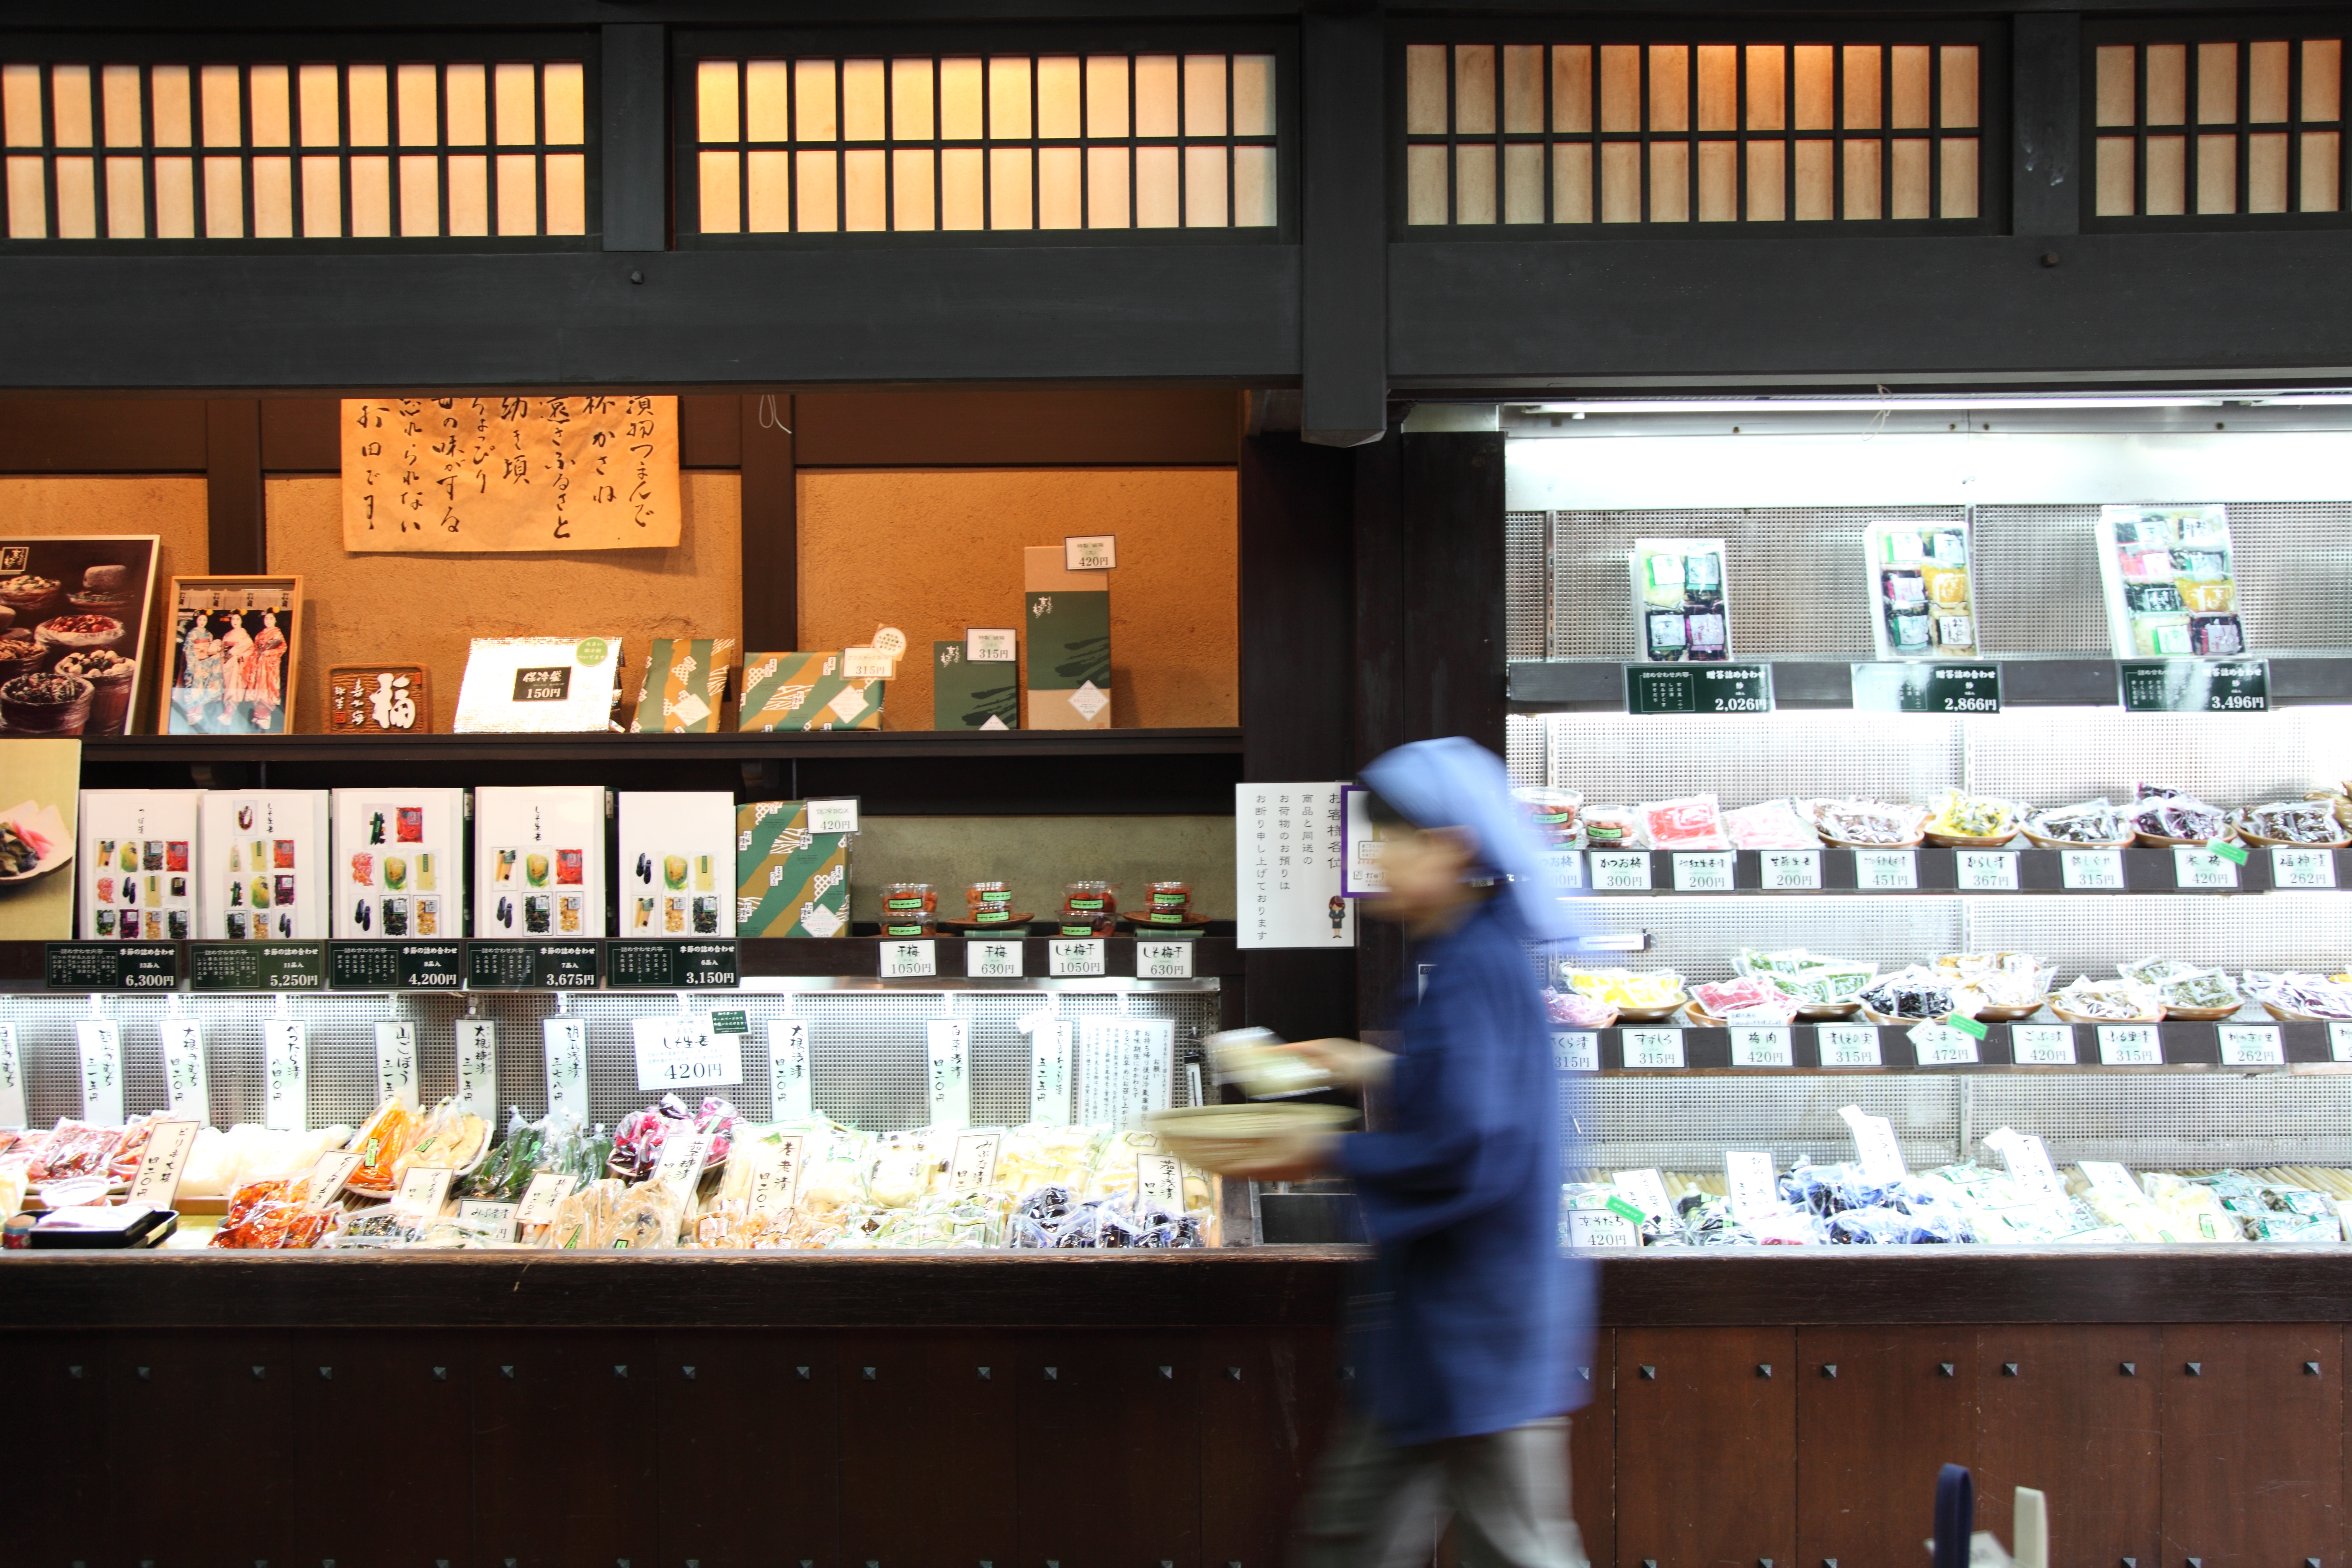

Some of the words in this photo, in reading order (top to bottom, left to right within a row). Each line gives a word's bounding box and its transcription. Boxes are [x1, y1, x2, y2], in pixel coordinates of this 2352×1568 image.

[1079, 557, 1109, 567] 420円
[979, 649, 1008, 659] 315円
[522, 670, 562, 682] 保冷袋
[856, 666, 885, 674] 315円
[526, 688, 561, 698] 150円
[1715, 698, 1767, 711] 2,026円
[1945, 698, 1997, 711] 2,866円
[2211, 696, 2264, 709] 3,496円
[820, 820, 851, 830] 420円
[1302, 794, 1314, 865] 商品と同送の
[1279, 795, 1290, 890] お荷物のお預りは
[1535, 855, 1575, 867] つお梅
[1600, 856, 1644, 869] かつお梅
[2280, 854, 2326, 867] 福神漬
[1255, 795, 1268, 940] お断り申し上げております
[1545, 875, 1577, 886] 00円
[1607, 875, 1642, 887] 300円
[1689, 876, 1725, 887] 200円
[1777, 875, 1812, 886] 200円
[1872, 875, 1908, 886] 451円
[1973, 875, 2009, 887] 367円
[2079, 874, 2114, 885] 315円
[2192, 873, 2228, 884] 420円
[2290, 873, 2326, 884] 262円
[1055, 943, 1096, 956] しそ梅干
[1143, 946, 1184, 959] しそ梅干
[891, 963, 931, 974] 1050円
[981, 964, 1014, 974] 630円
[1060, 962, 1100, 972] 1050円
[1151, 965, 1183, 975] 630円
[126, 975, 174, 987] 6,300円
[270, 975, 318, 986] 5,250円
[408, 974, 456, 985] 4,200円
[547, 974, 594, 986] 3,675円
[686, 972, 734, 984] 3,150円
[1634, 1032, 1672, 1047] すずしろ
[1748, 1032, 1777, 1044] 梅肉
[1826, 1032, 1872, 1045] 青しその実
[2105, 1029, 2152, 1044] ふる里漬
[183, 1026, 200, 1087] 大根きむち
[286, 1025, 302, 1080] べったら漬
[396, 1026, 413, 1085] 山ごぼう
[789, 1025, 807, 1079] 大根浅漬
[950, 1025, 965, 1080] 白菜浅漬
[1747, 1052, 1783, 1063] 420円
[1836, 1051, 1872, 1063] 315円
[1932, 1050, 1968, 1061] 472円
[2030, 1050, 2066, 1061] 420円
[2116, 1050, 2153, 1062] 315円
[2238, 1050, 2275, 1062] 262円
[1555, 1056, 1589, 1068] 315円
[1639, 1053, 1675, 1064] 315円
[664, 1062, 722, 1080] 420円
[1121, 1029, 1130, 1132] なるべくお早めにお召し上がり下
[1578, 1215, 1625, 1227] 京そだち
[1588, 1234, 1627, 1246] 420円
